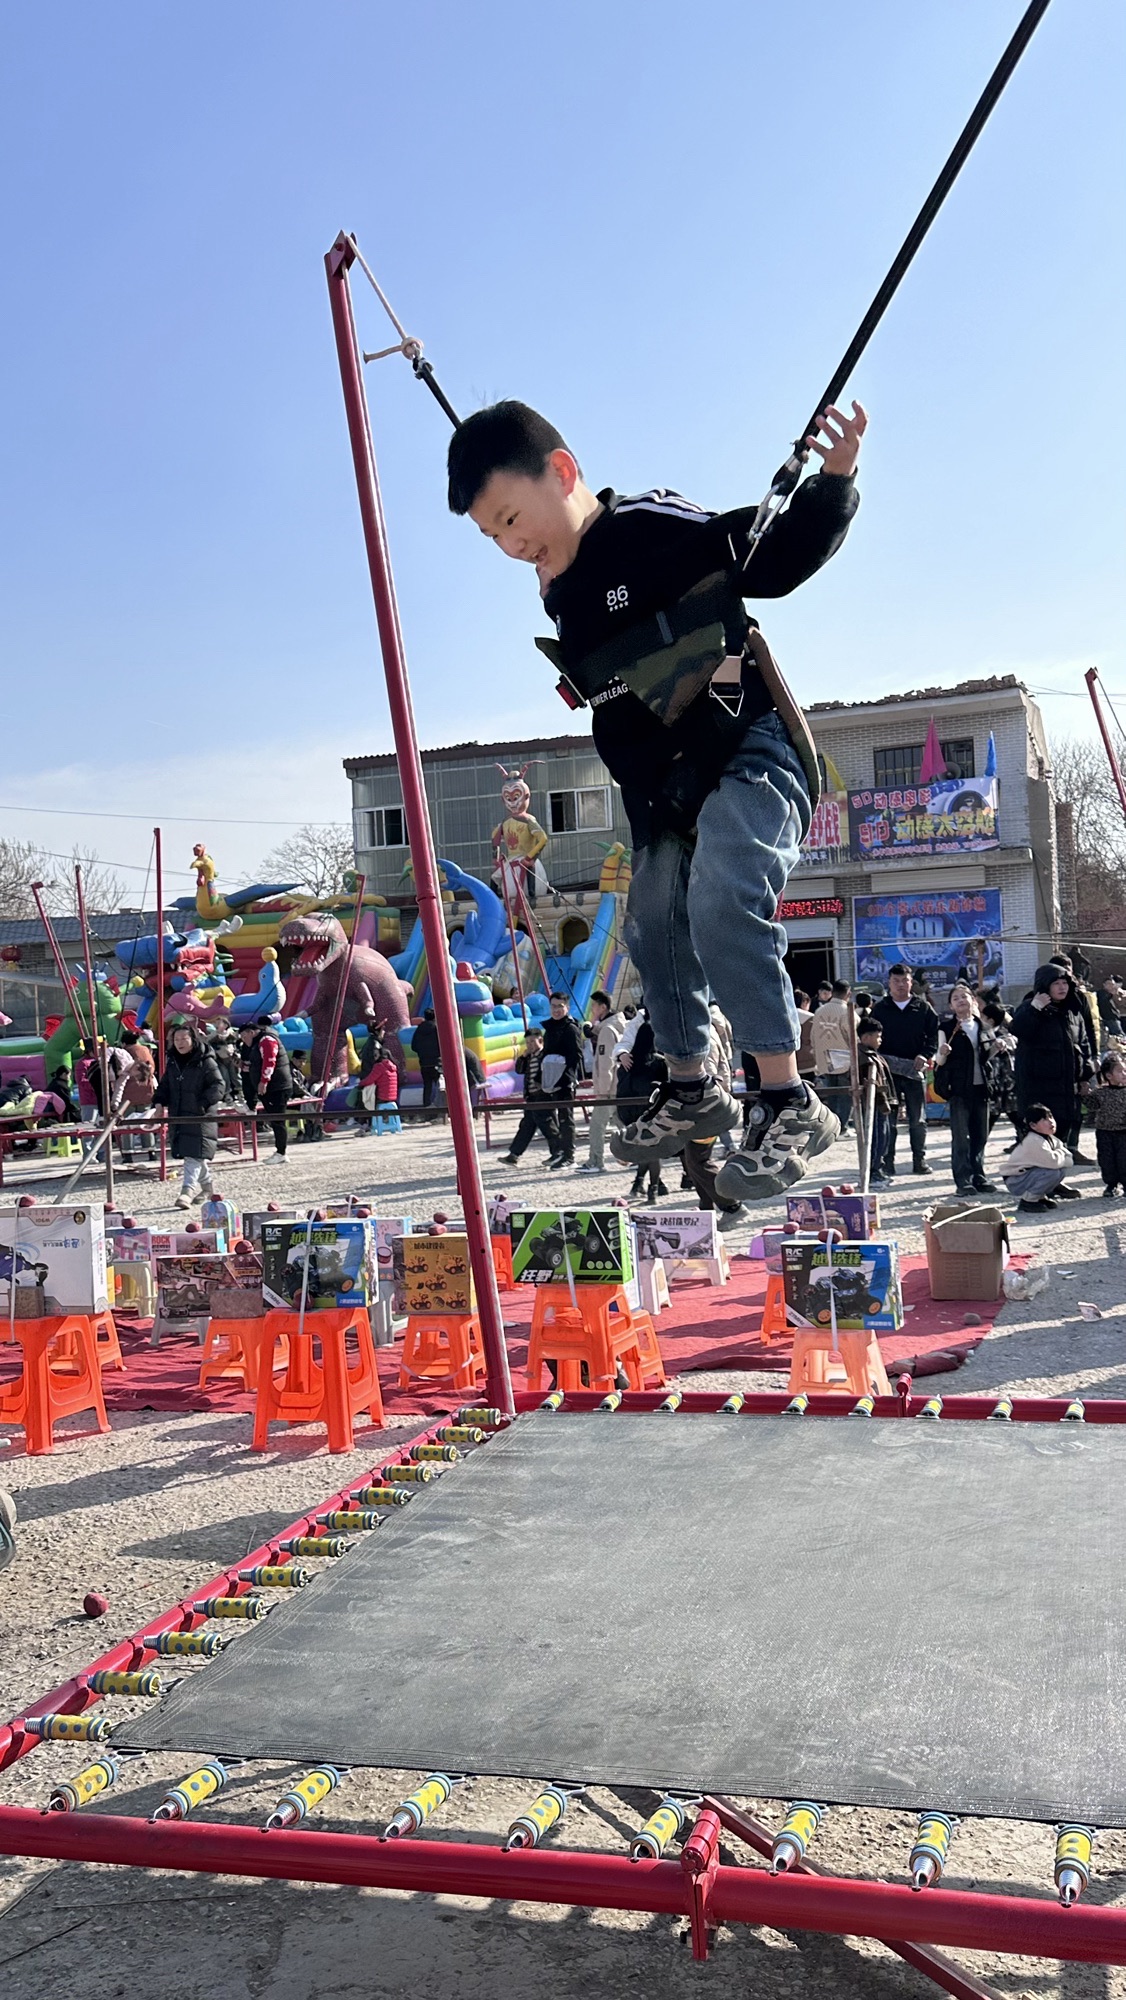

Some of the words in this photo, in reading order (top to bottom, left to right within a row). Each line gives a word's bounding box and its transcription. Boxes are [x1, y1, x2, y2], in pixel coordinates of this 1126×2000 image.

[606, 585, 629, 606] 86
[608, 683, 632, 700] LEAG
[803, 801, 841, 848] 野战
[265, 1227, 283, 1235] R/C
[785, 1248, 803, 1256] R/C
[520, 1269, 553, 1282] 狂野
